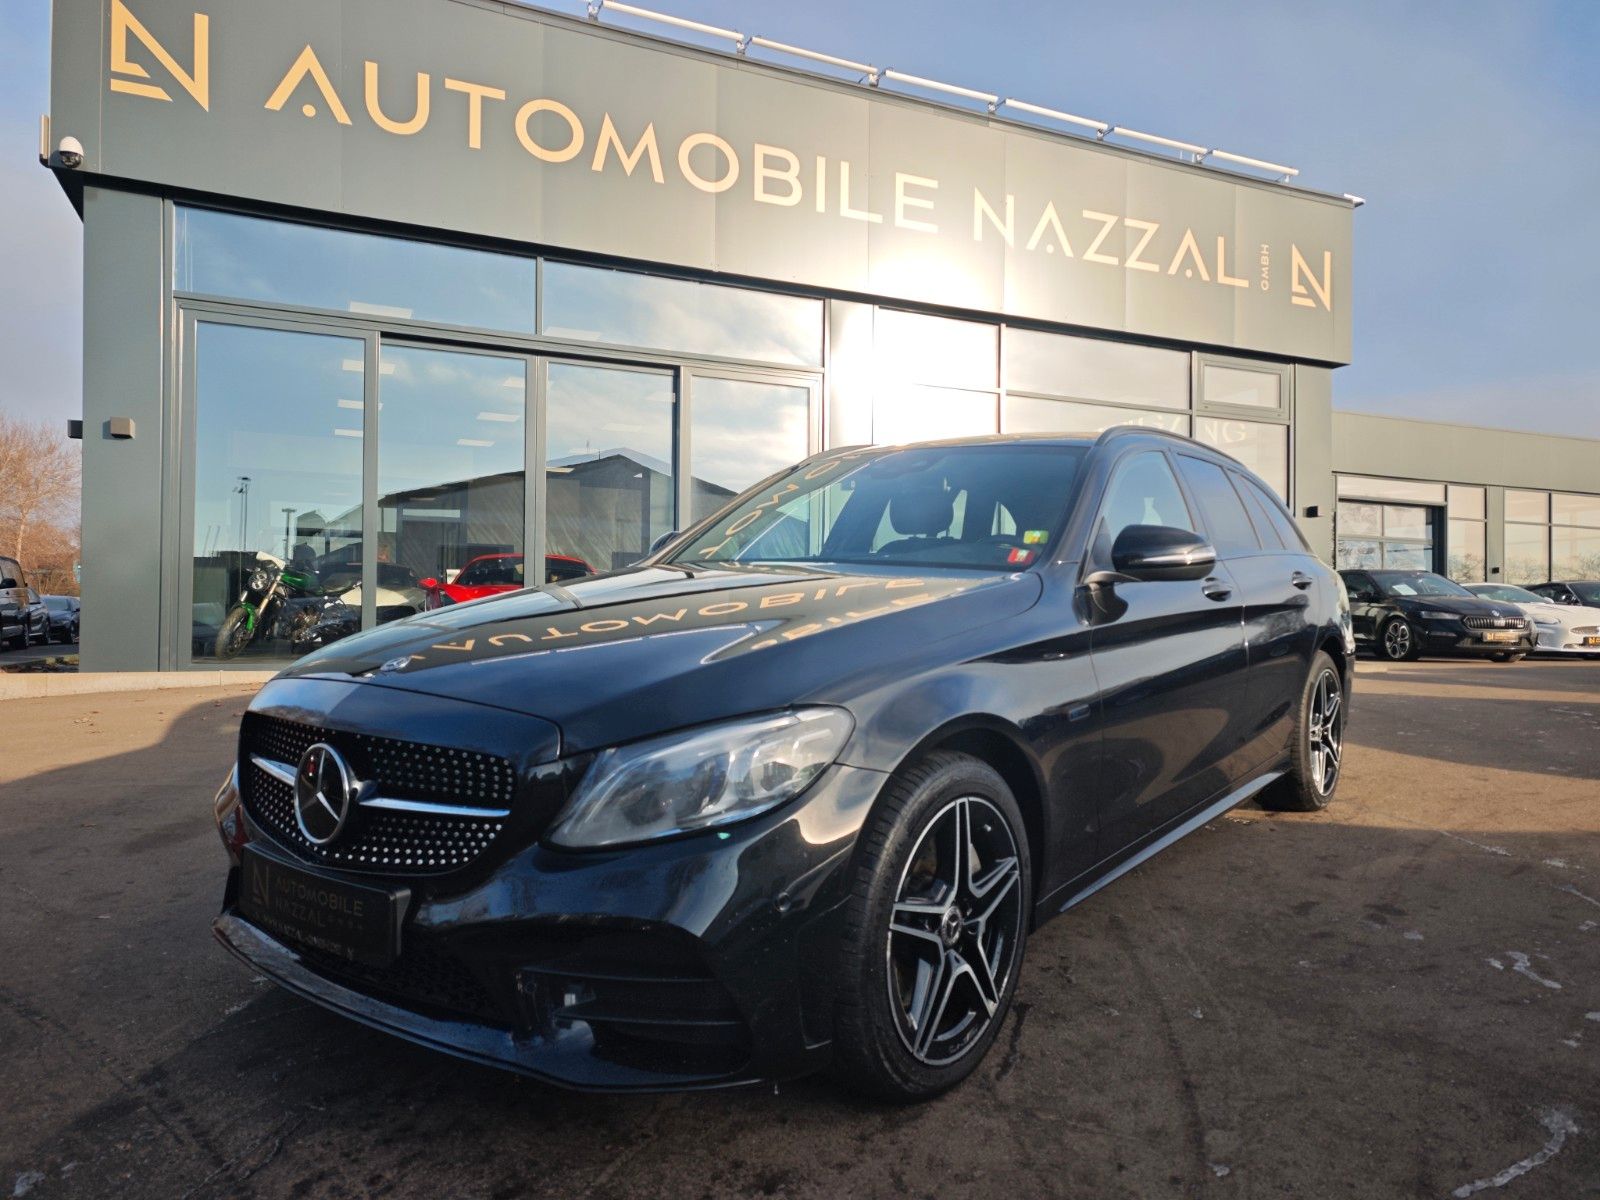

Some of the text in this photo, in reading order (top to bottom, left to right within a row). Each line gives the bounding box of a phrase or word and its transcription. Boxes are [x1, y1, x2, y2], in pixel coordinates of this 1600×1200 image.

[264, 44, 1249, 289] AUTOMOBILE NAZZAL
[275, 876, 364, 917] AUTOMOBILE
